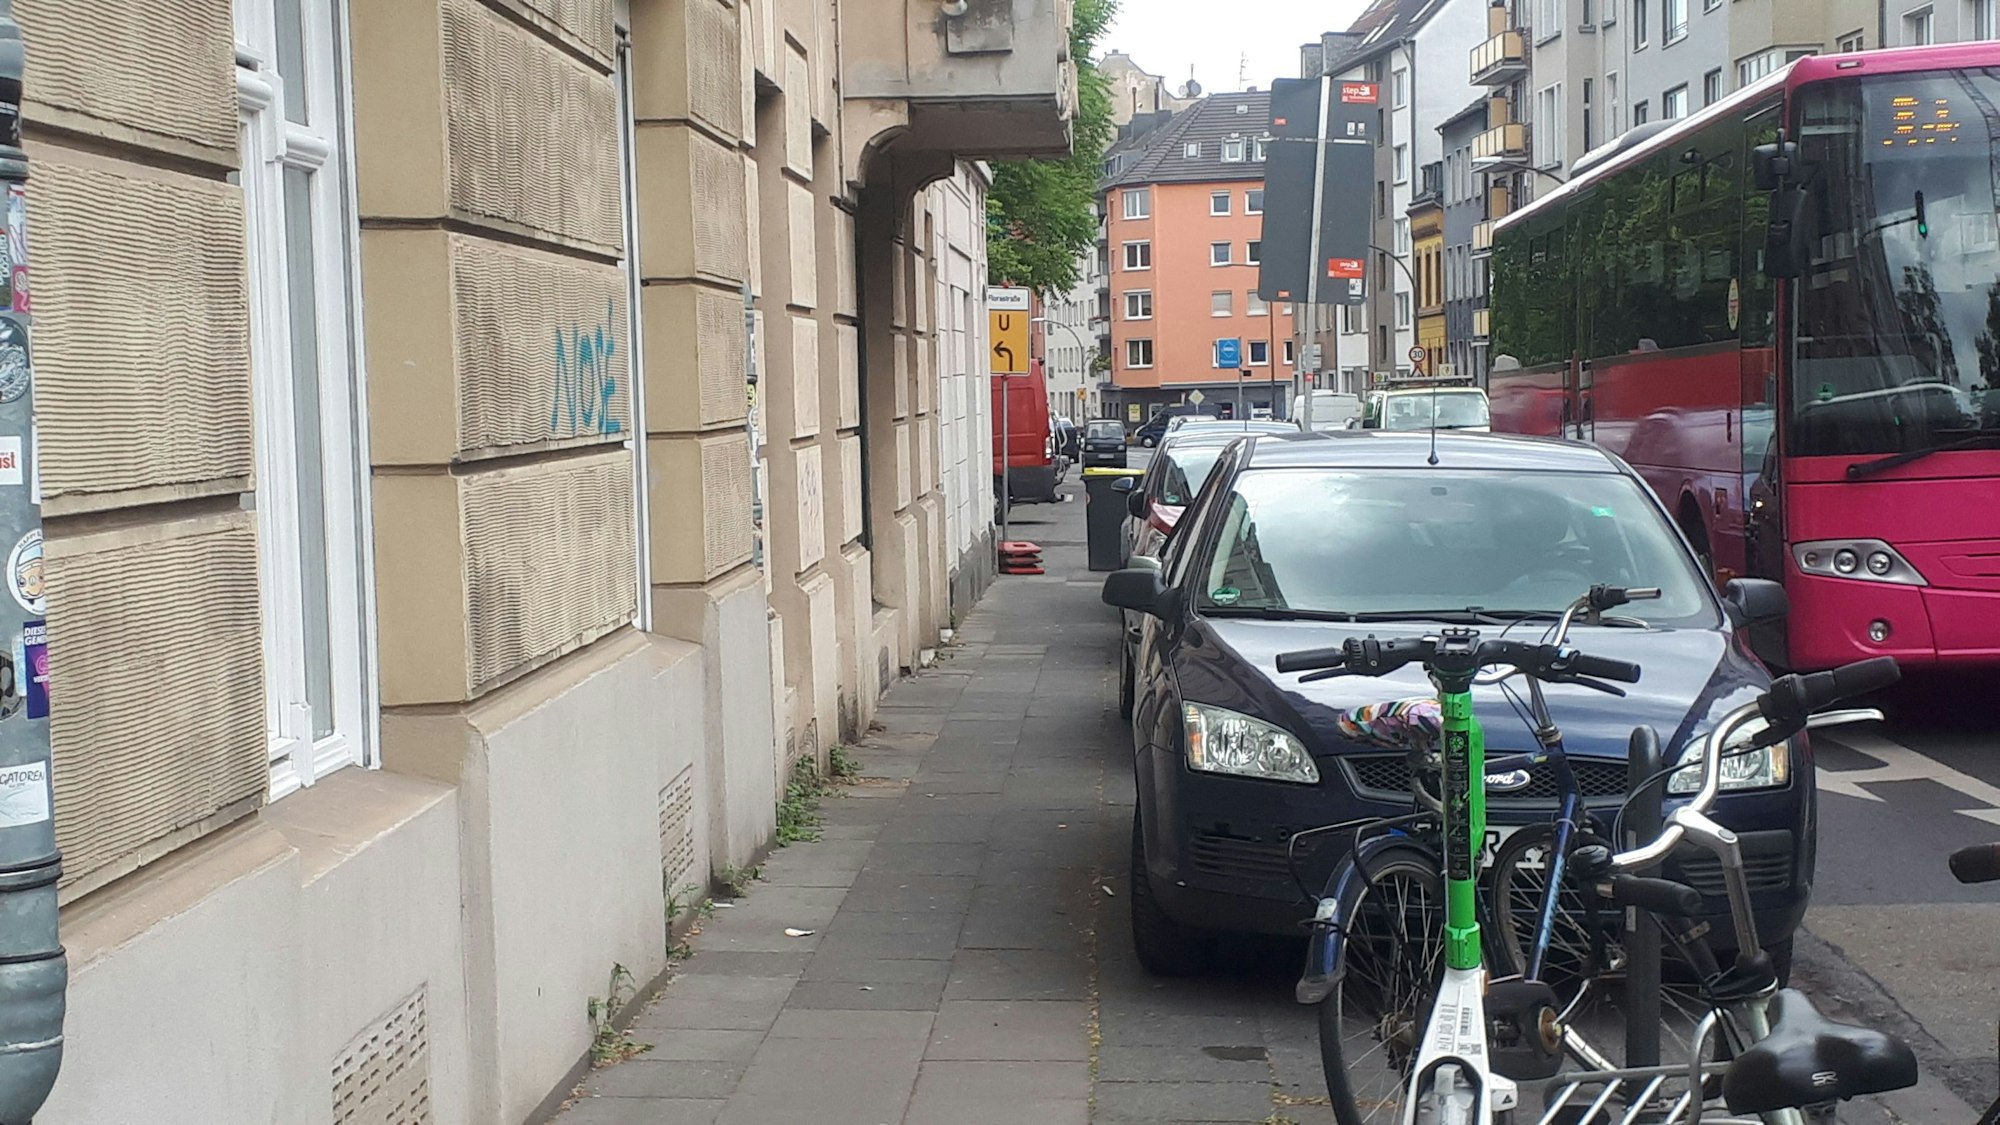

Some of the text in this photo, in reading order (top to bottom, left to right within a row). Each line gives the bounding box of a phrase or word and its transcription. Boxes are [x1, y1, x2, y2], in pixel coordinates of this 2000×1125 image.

[998, 313, 1010, 331] U
[1412, 350, 1423, 359] 30
[1484, 772, 1514, 784] ord
